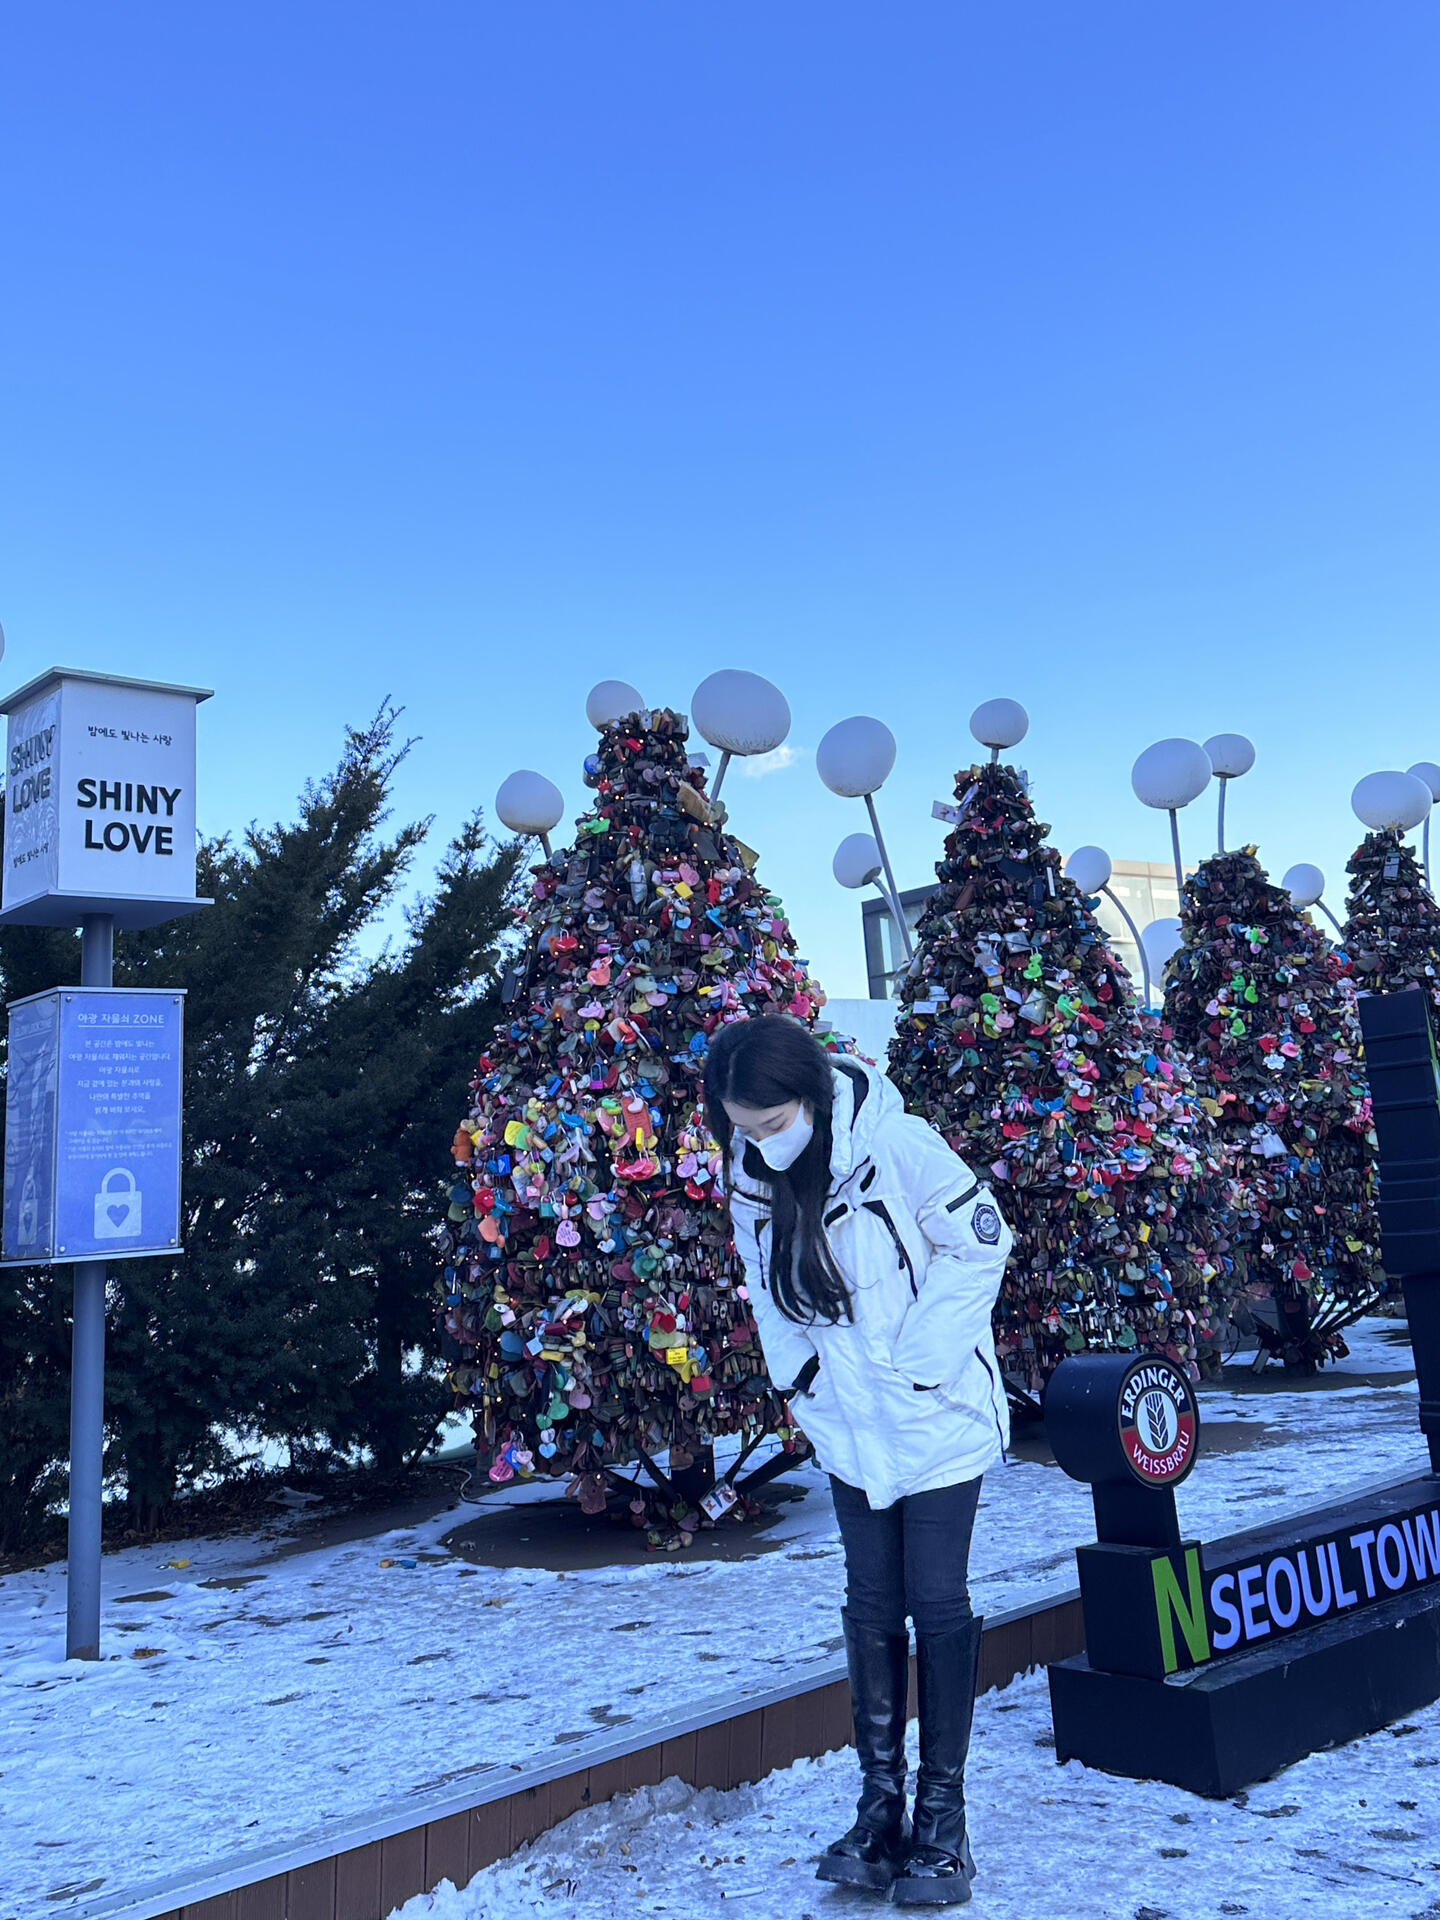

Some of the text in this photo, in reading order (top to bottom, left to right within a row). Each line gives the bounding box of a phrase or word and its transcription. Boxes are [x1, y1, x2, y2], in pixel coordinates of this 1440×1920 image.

[10, 724, 56, 777] SHINY
[87, 725, 173, 746] 밤에도 빛나는 사랑
[12, 766, 51, 814] LOVE
[77, 778, 182, 816] SHINY
[84, 819, 174, 856] LOVE
[77, 1013, 165, 1025] 야광 자물쇠 ZONE
[1121, 1366, 1186, 1419] ERDINGER
[1133, 1430, 1190, 1475] WEISSBRÄU
[1151, 1547, 1211, 1674] N
[1210, 1541, 1359, 1650] SEOUL
